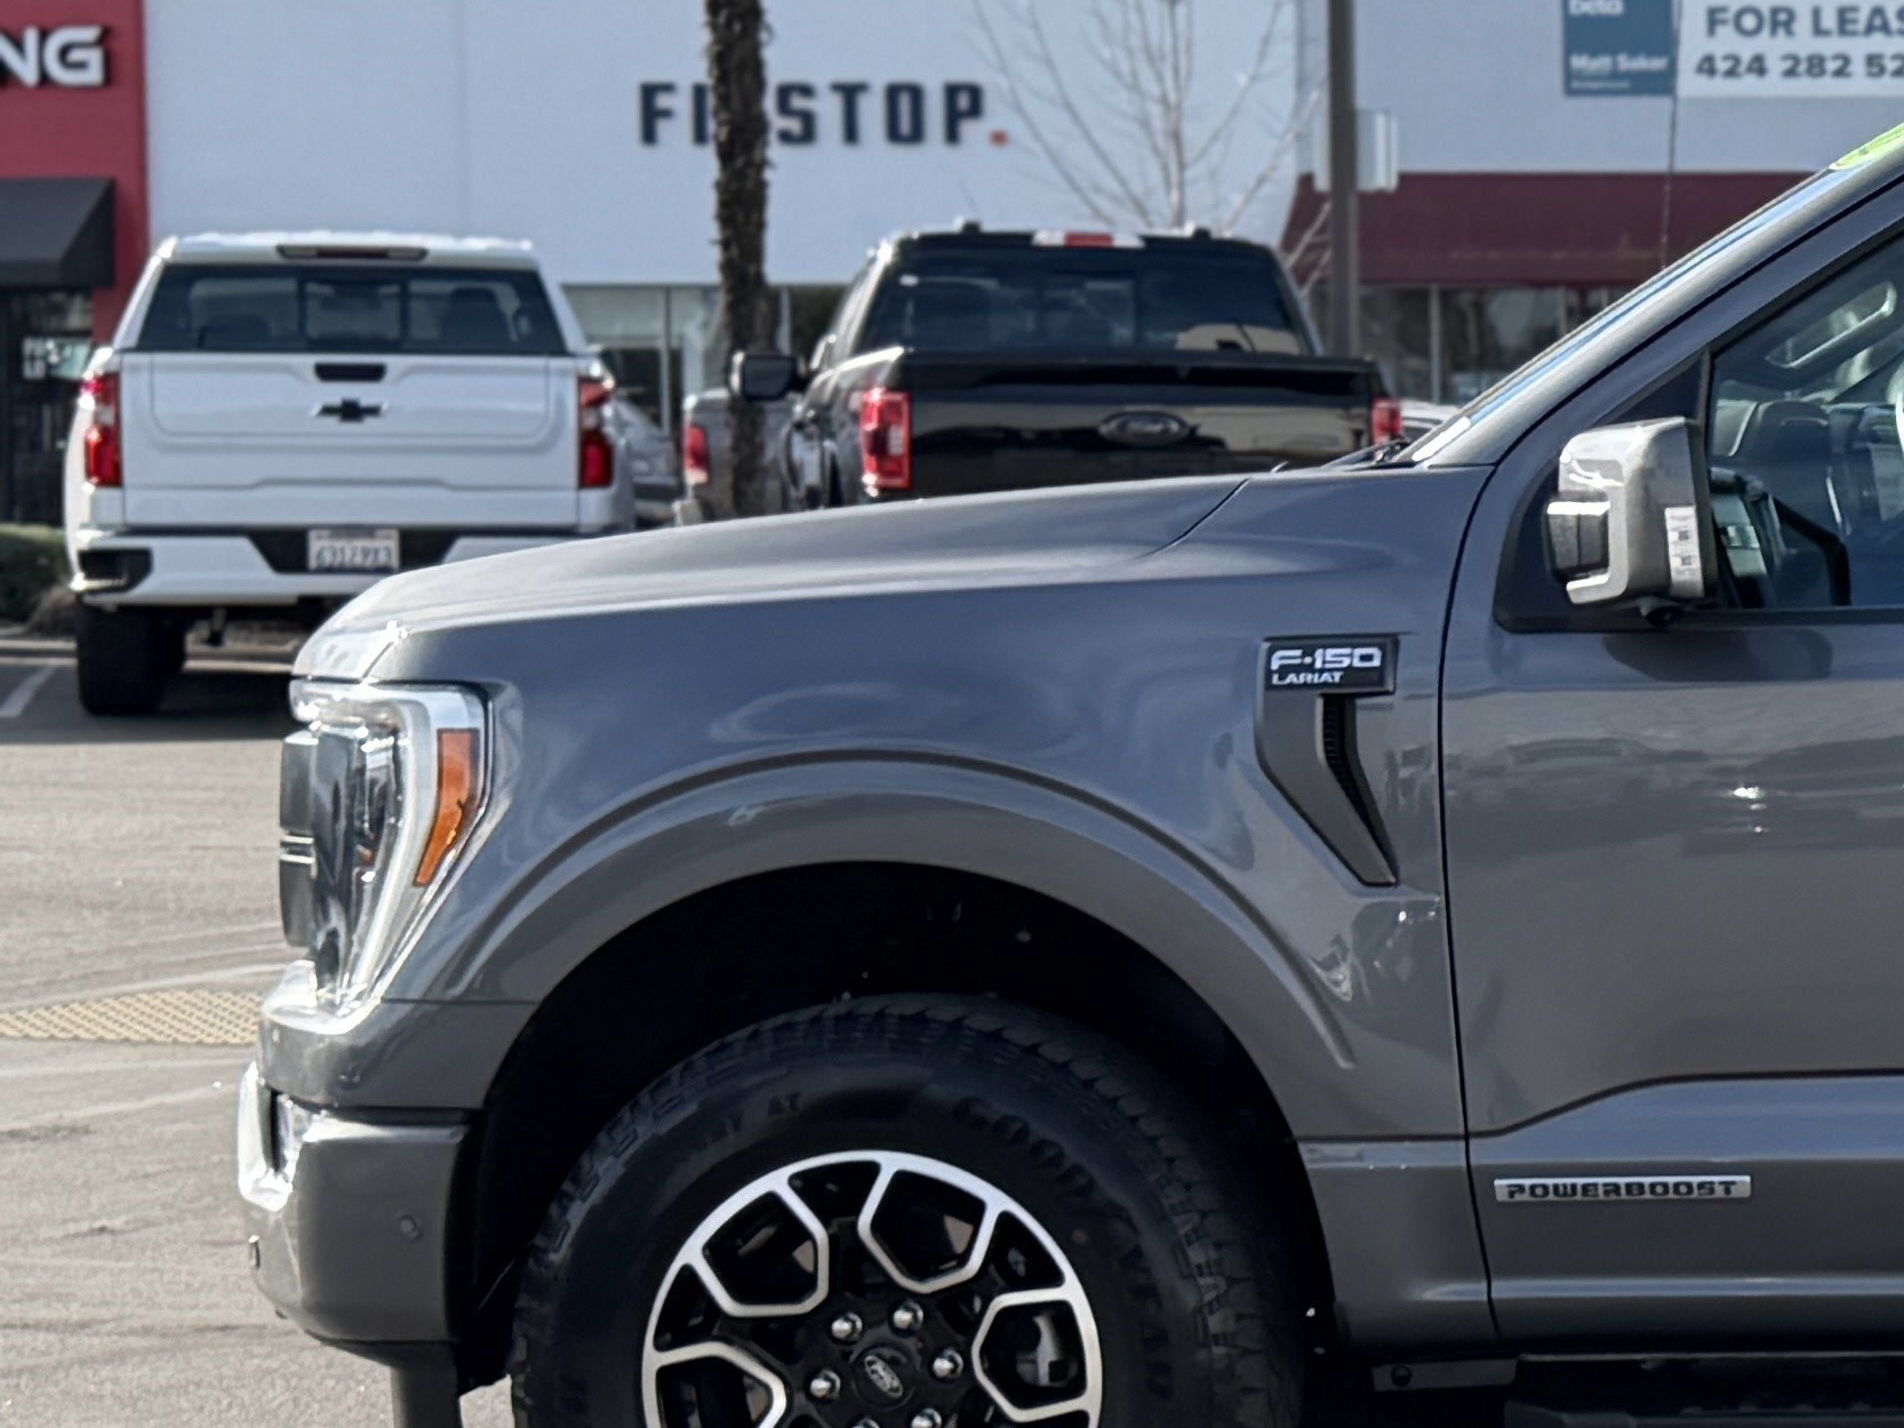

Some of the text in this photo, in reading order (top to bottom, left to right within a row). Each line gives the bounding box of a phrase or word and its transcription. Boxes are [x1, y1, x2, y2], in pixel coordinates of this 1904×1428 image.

[1706, 5, 1797, 37] FOR
[1695, 54, 1767, 78] 424
[1780, 54, 1853, 78] 282
[639, 82, 1008, 146] FISTOP.
[1272, 671, 1344, 685] LARIAT
[1506, 1181, 1737, 1199] POWERBOOST
